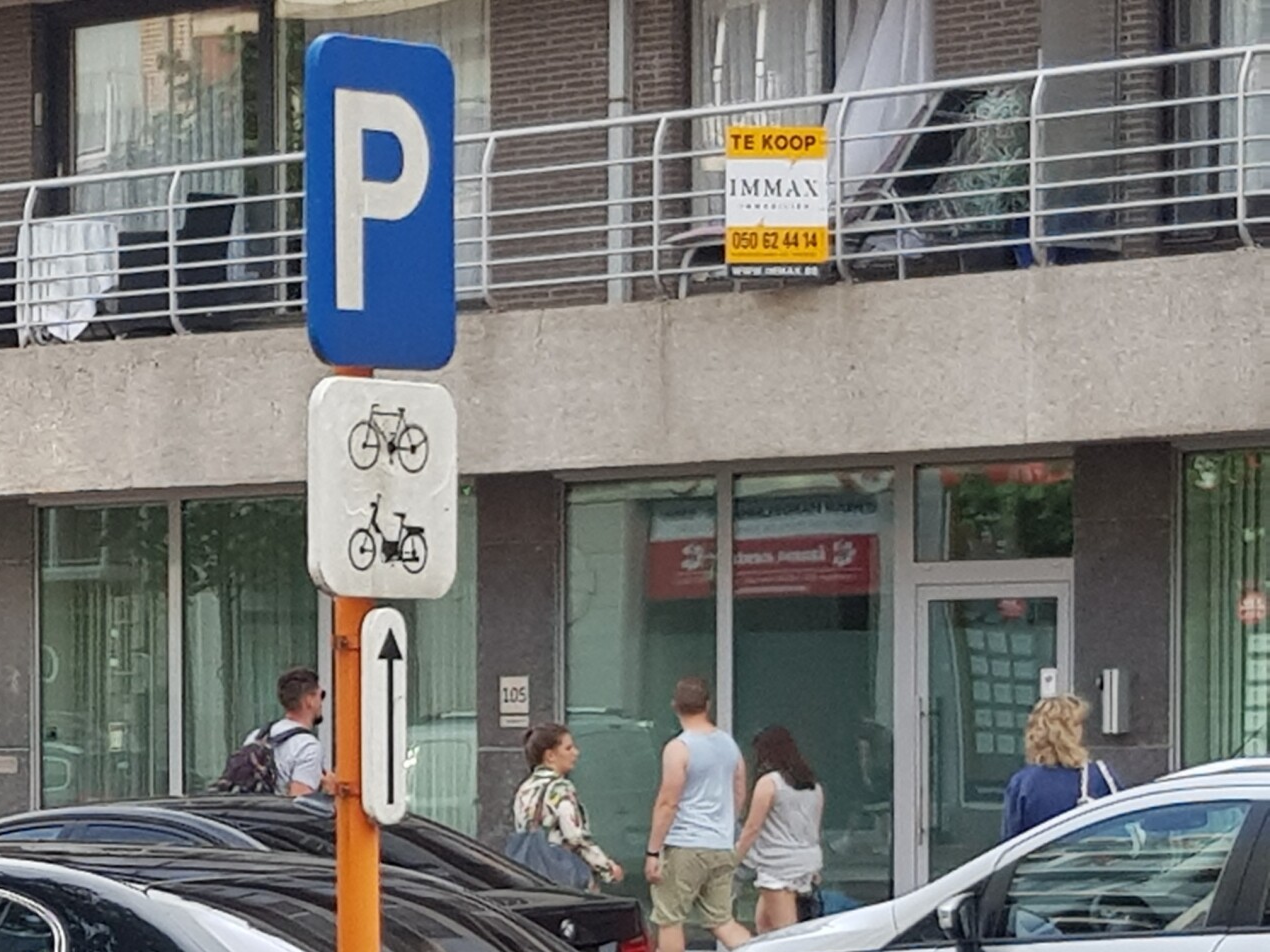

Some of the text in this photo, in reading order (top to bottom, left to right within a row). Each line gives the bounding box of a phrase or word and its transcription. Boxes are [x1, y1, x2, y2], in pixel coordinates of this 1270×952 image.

[731, 135, 816, 150] TE KOOP
[730, 179, 818, 197] IMMAX
[335, 88, 429, 311] P
[732, 232, 818, 249] 050 62 44 14
[503, 687, 527, 703] 105
